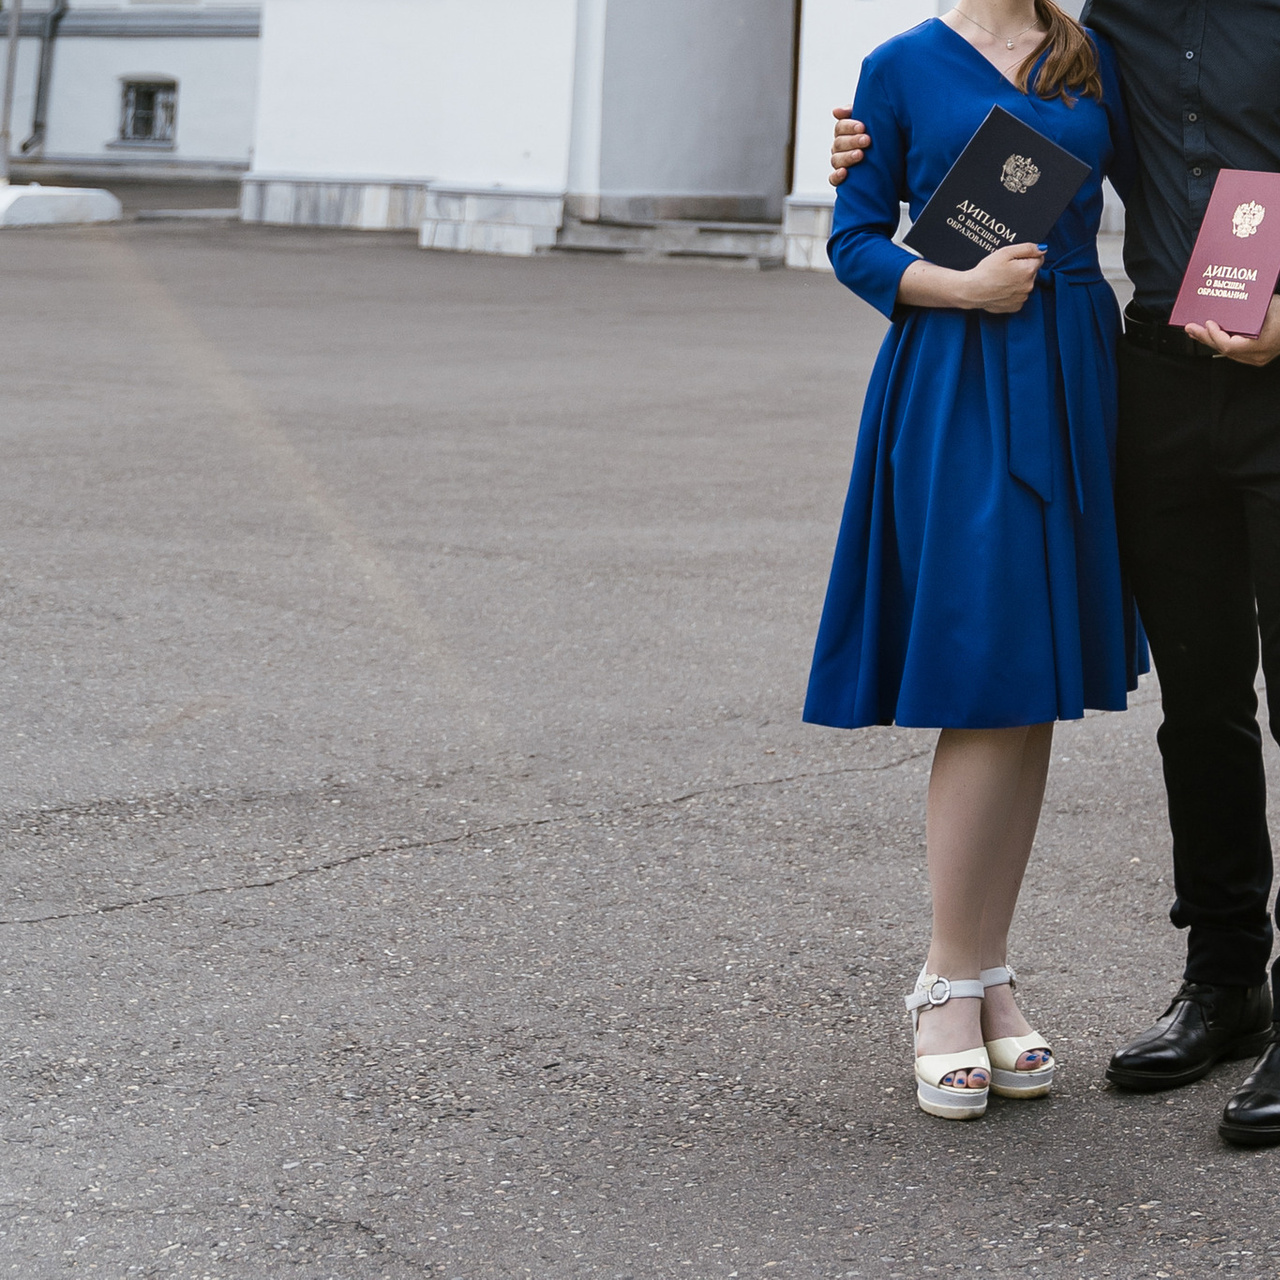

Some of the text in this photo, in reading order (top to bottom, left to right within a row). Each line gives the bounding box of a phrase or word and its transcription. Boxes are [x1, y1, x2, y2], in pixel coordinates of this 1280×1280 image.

[956, 199, 1017, 243] ДИПЛОМ
[946, 217, 997, 253] ОБРАЗОВАНИ
[965, 219, 1001, 246] ВЫСШЕМ
[1202, 264, 1258, 281] ДИПЛОМ
[1197, 287, 1249, 301] ОБРАЗОВАНИИ
[1213, 279, 1246, 290] ВЫСШЕМ
